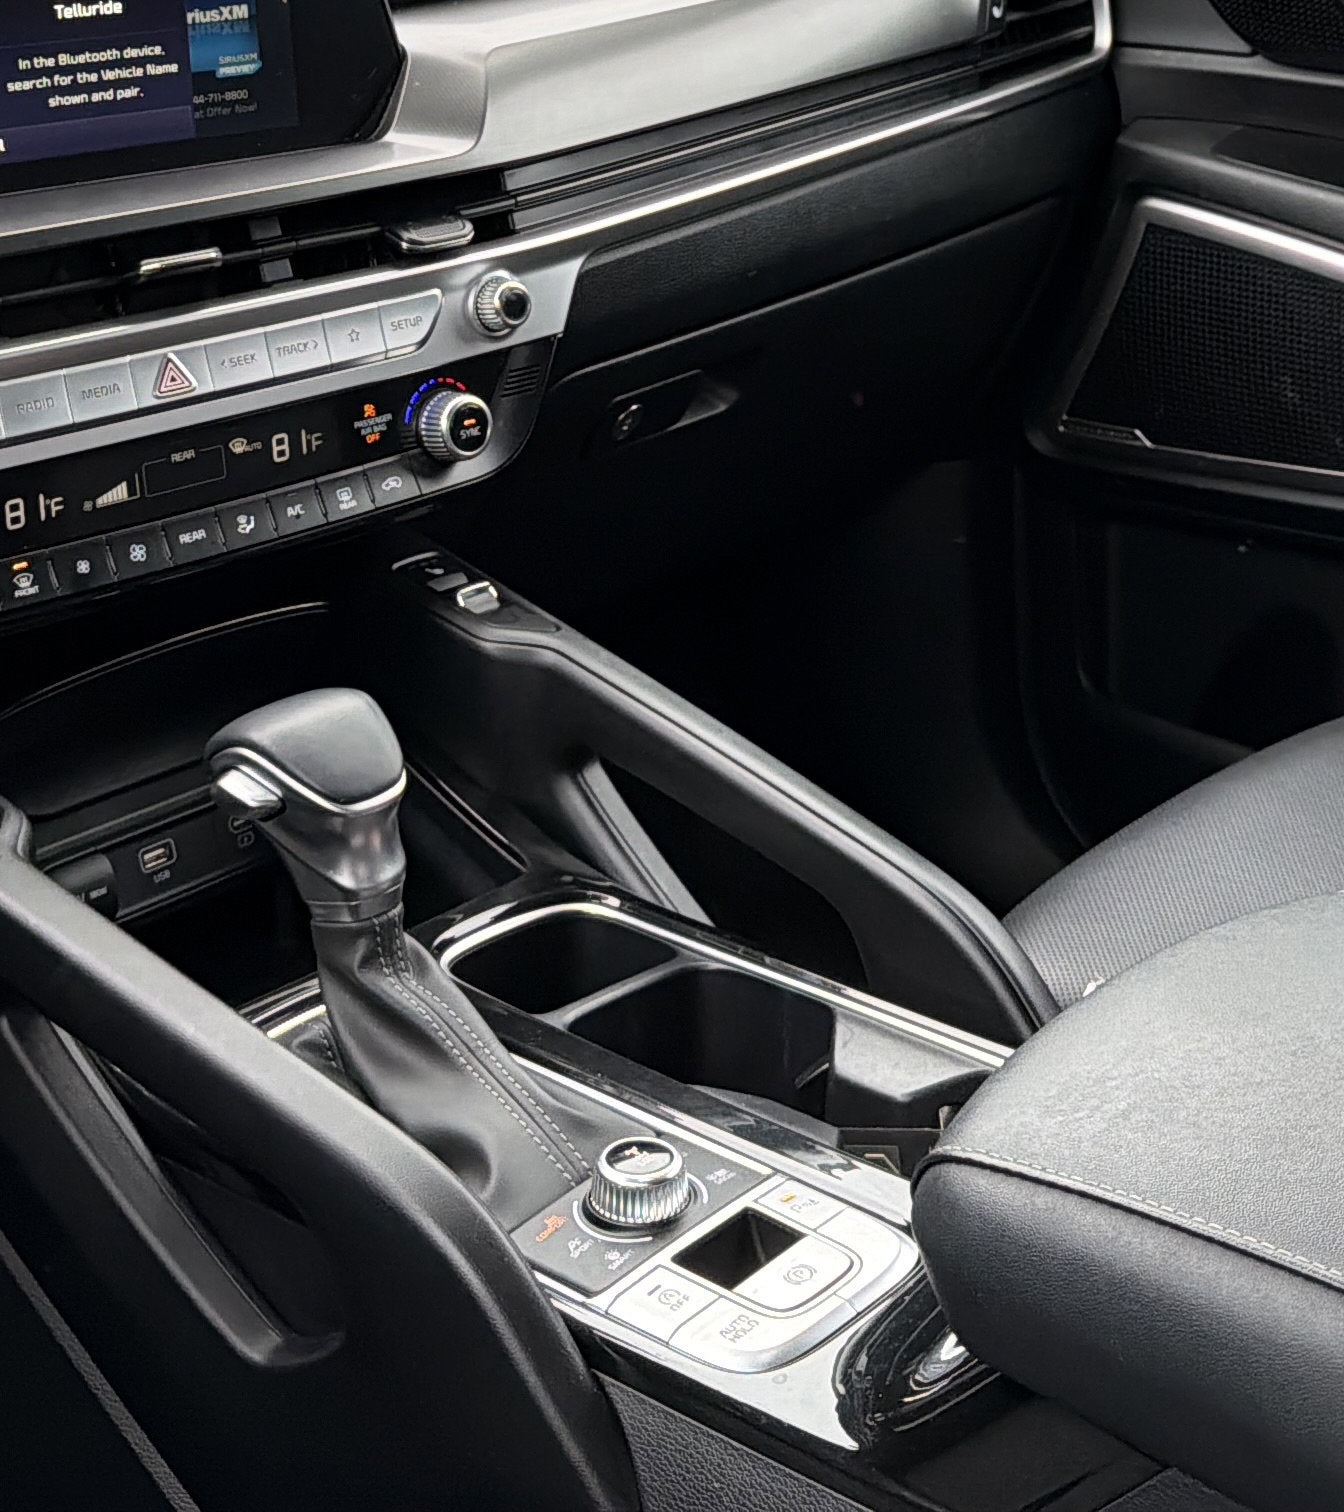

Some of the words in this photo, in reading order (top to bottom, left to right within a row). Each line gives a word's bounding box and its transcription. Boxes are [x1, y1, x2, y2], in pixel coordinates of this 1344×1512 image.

[53, 0, 123, 20] Telluride
[18, 57, 32, 71] In
[33, 54, 56, 70] the
[58, 47, 121, 66] Bluetooth
[6, 77, 52, 93] search
[53, 74, 74, 88] for
[76, 71, 99, 85] the
[100, 67, 145, 82] Vehicle
[146, 62, 179, 77] Name
[48, 93, 90, 108] shown
[90, 88, 115, 103] and
[116, 85, 145, 102] pair.
[390, 315, 423, 331] SETUP
[230, 353, 257, 367] SEEK
[275, 341, 310, 357] TRACK
[81, 382, 121, 400] MEDIA
[16, 396, 55, 415] RADIO
[171, 448, 196, 463] REAR
[286, 503, 305, 518] A/C
[178, 528, 207, 545] REAR
[153, 869, 172, 884] USB
[719, 1314, 750, 1340] AUTO
